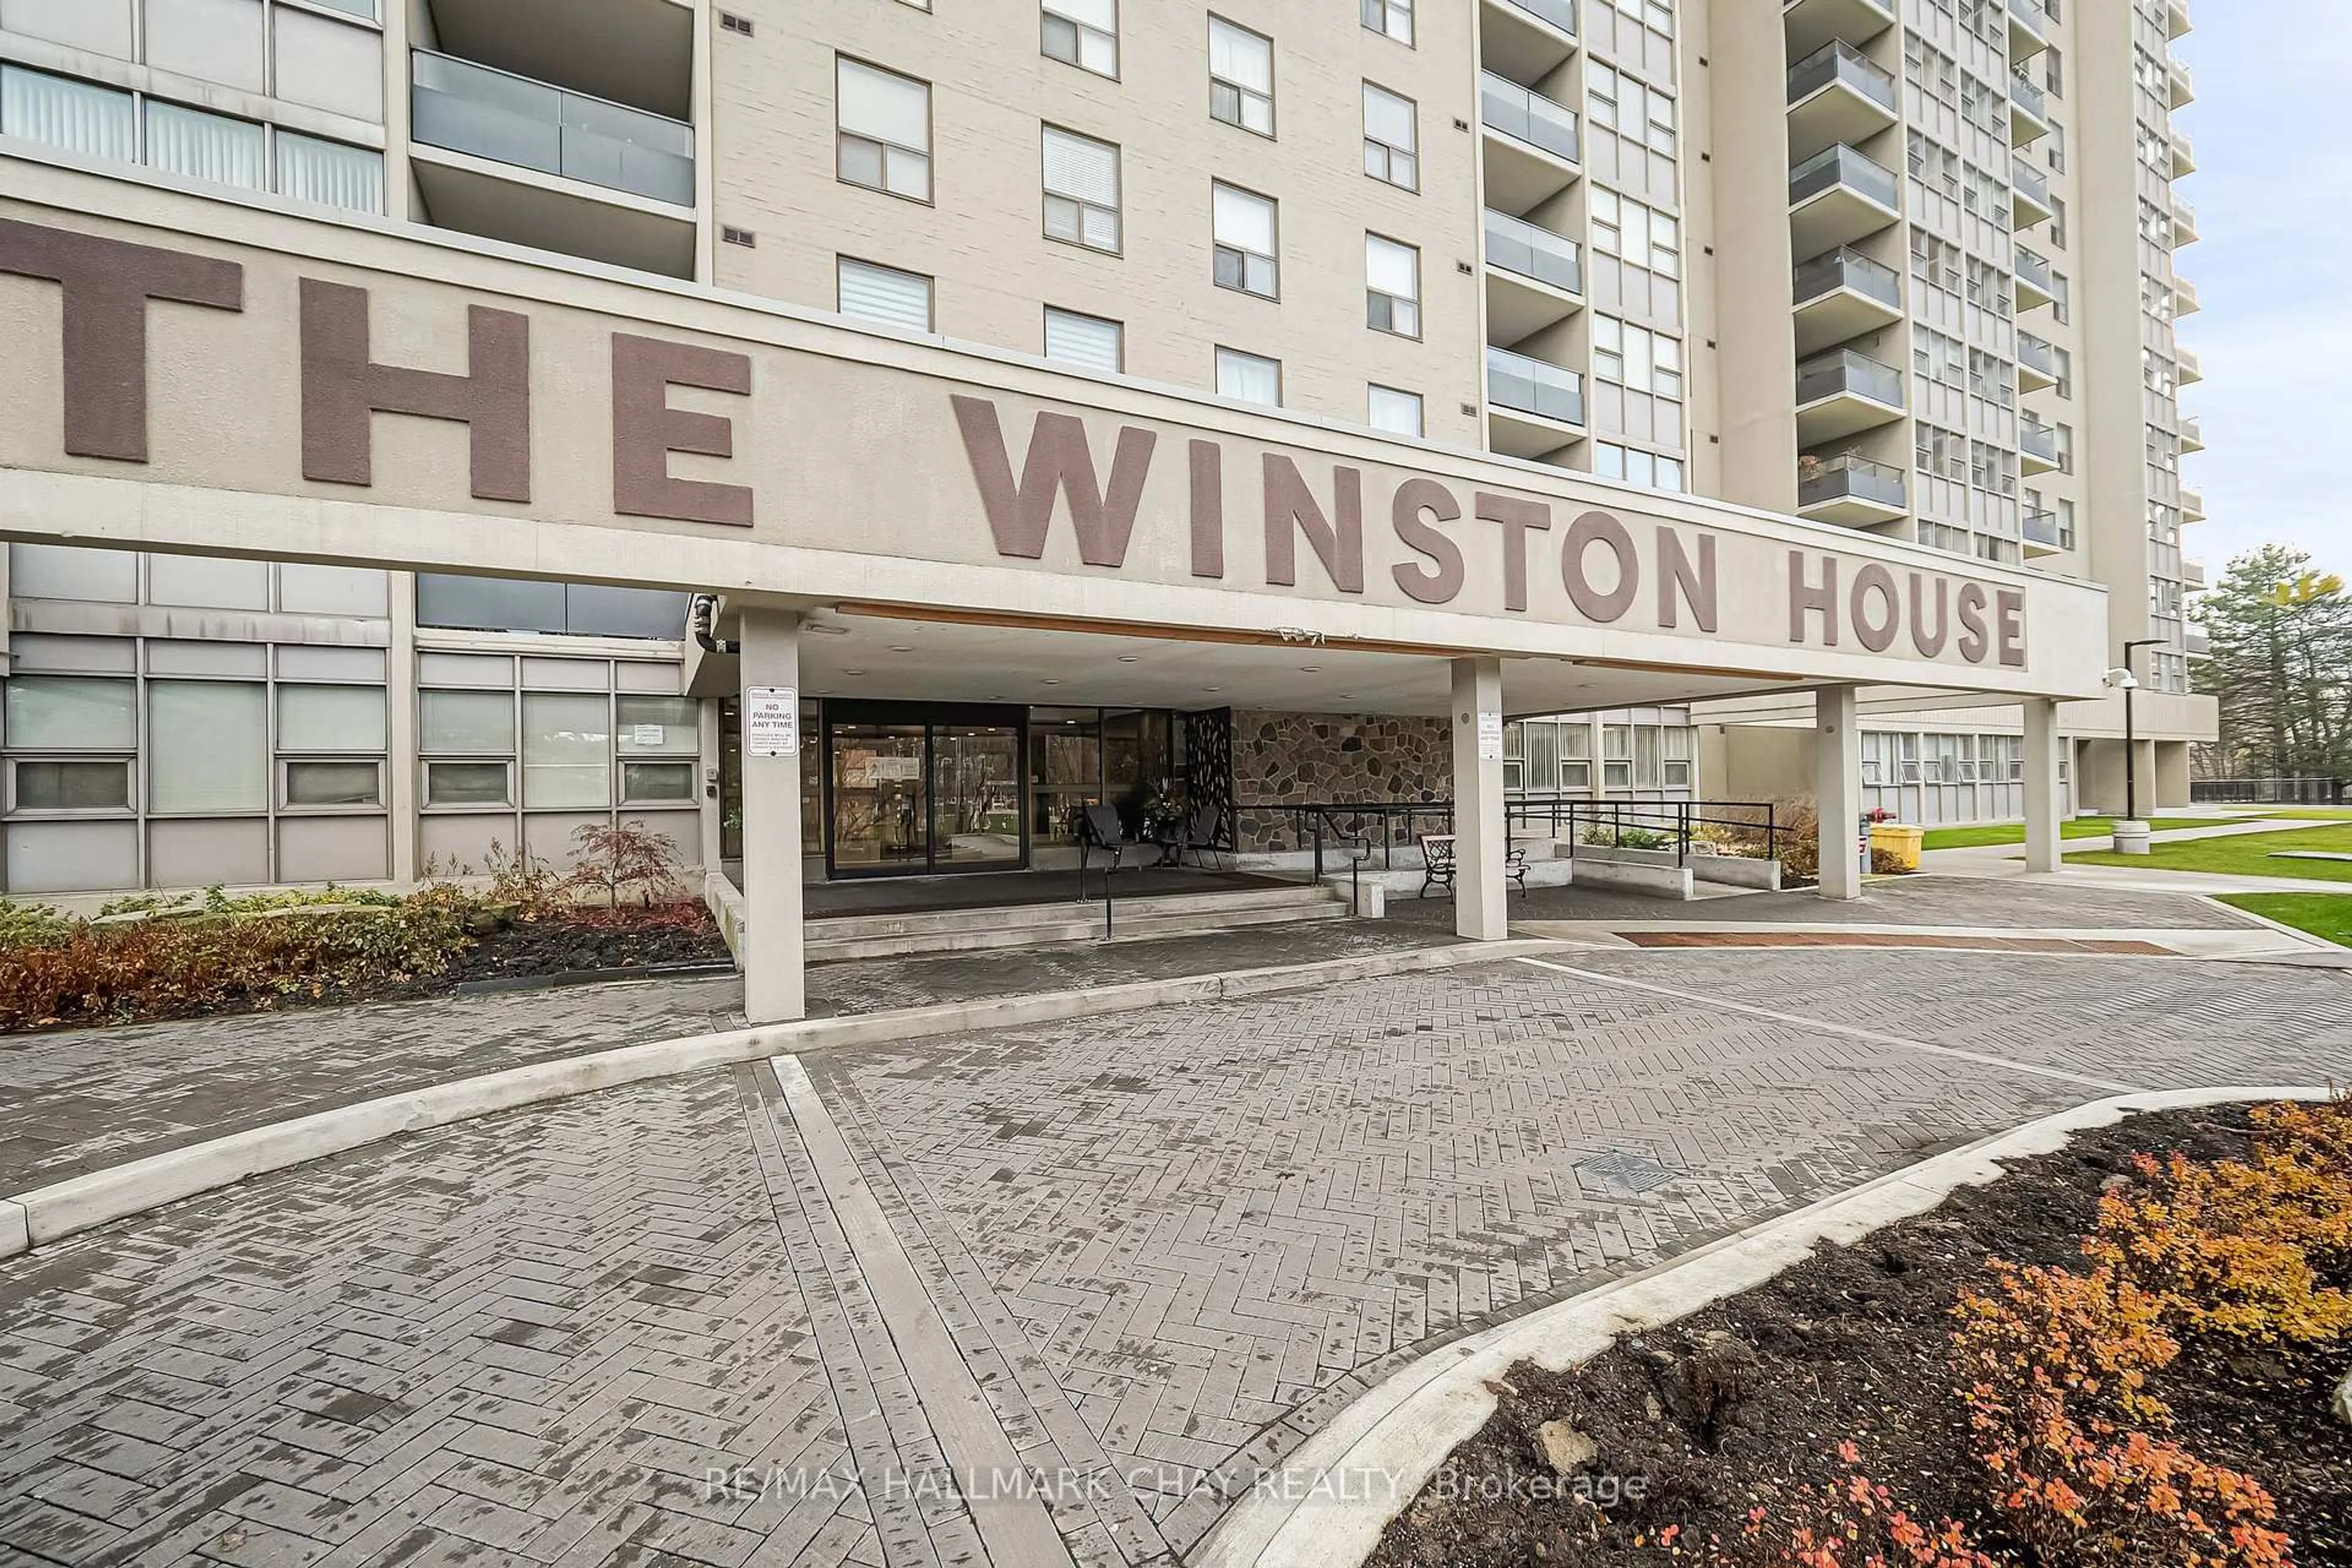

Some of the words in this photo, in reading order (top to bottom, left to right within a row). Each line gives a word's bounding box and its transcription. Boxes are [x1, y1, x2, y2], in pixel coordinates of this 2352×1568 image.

[0, 217, 754, 528] THE
[951, 394, 1717, 633] WINSTON
[1789, 551, 2024, 666] HOUSE
